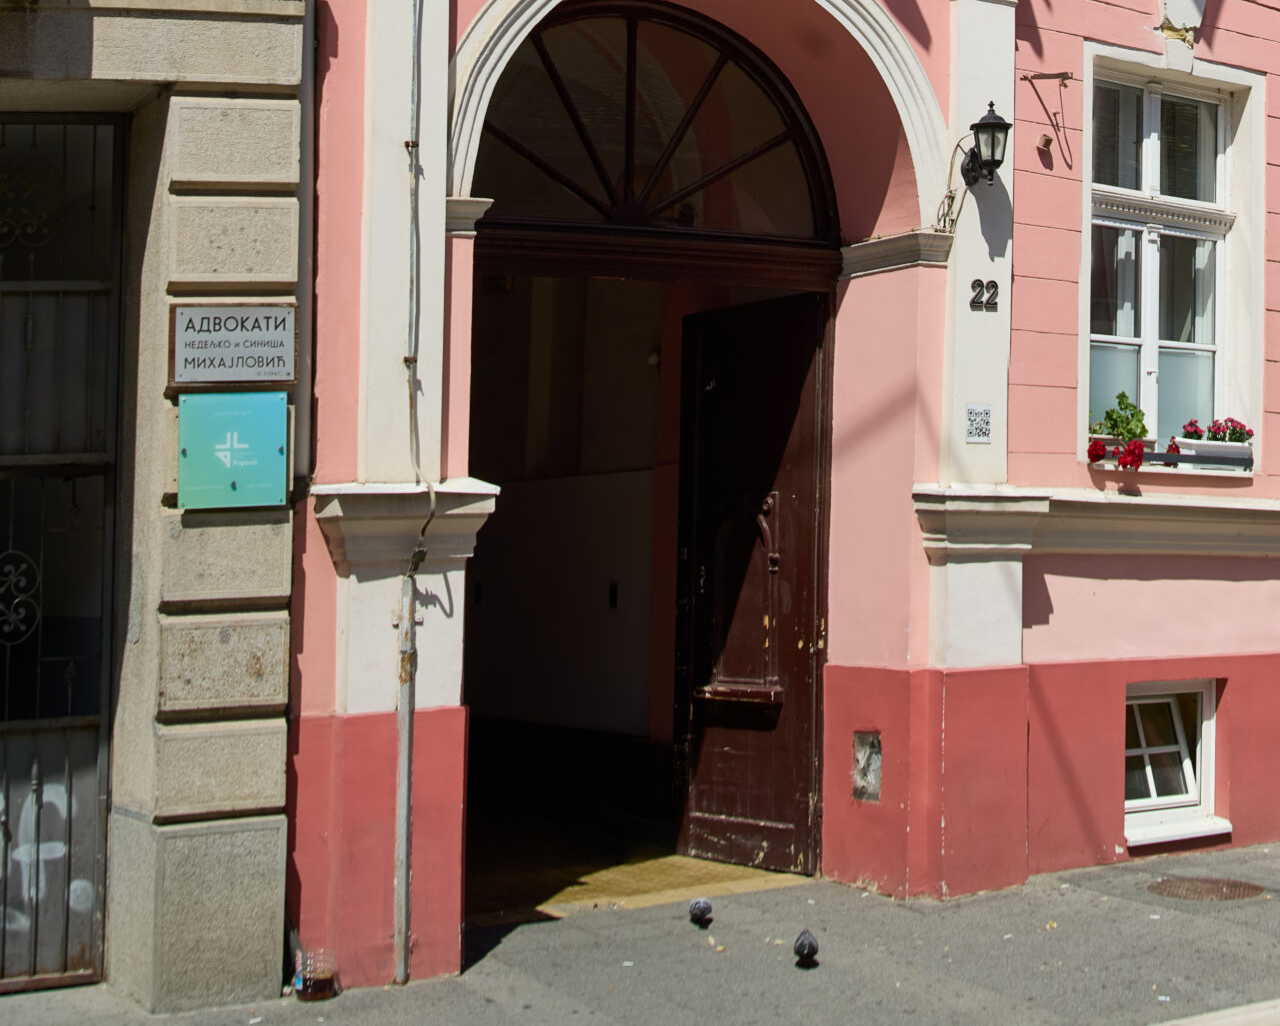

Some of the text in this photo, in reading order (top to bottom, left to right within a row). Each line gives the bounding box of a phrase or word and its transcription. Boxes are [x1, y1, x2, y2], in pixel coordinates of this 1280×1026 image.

[969, 278, 999, 312] 22
[184, 316, 287, 334] АДВОКАТИ
[184, 340, 232, 350] НЕДЕЉКО
[243, 339, 285, 349] СИНИША
[184, 356, 286, 370] МИХАЈЛОВИЋ
